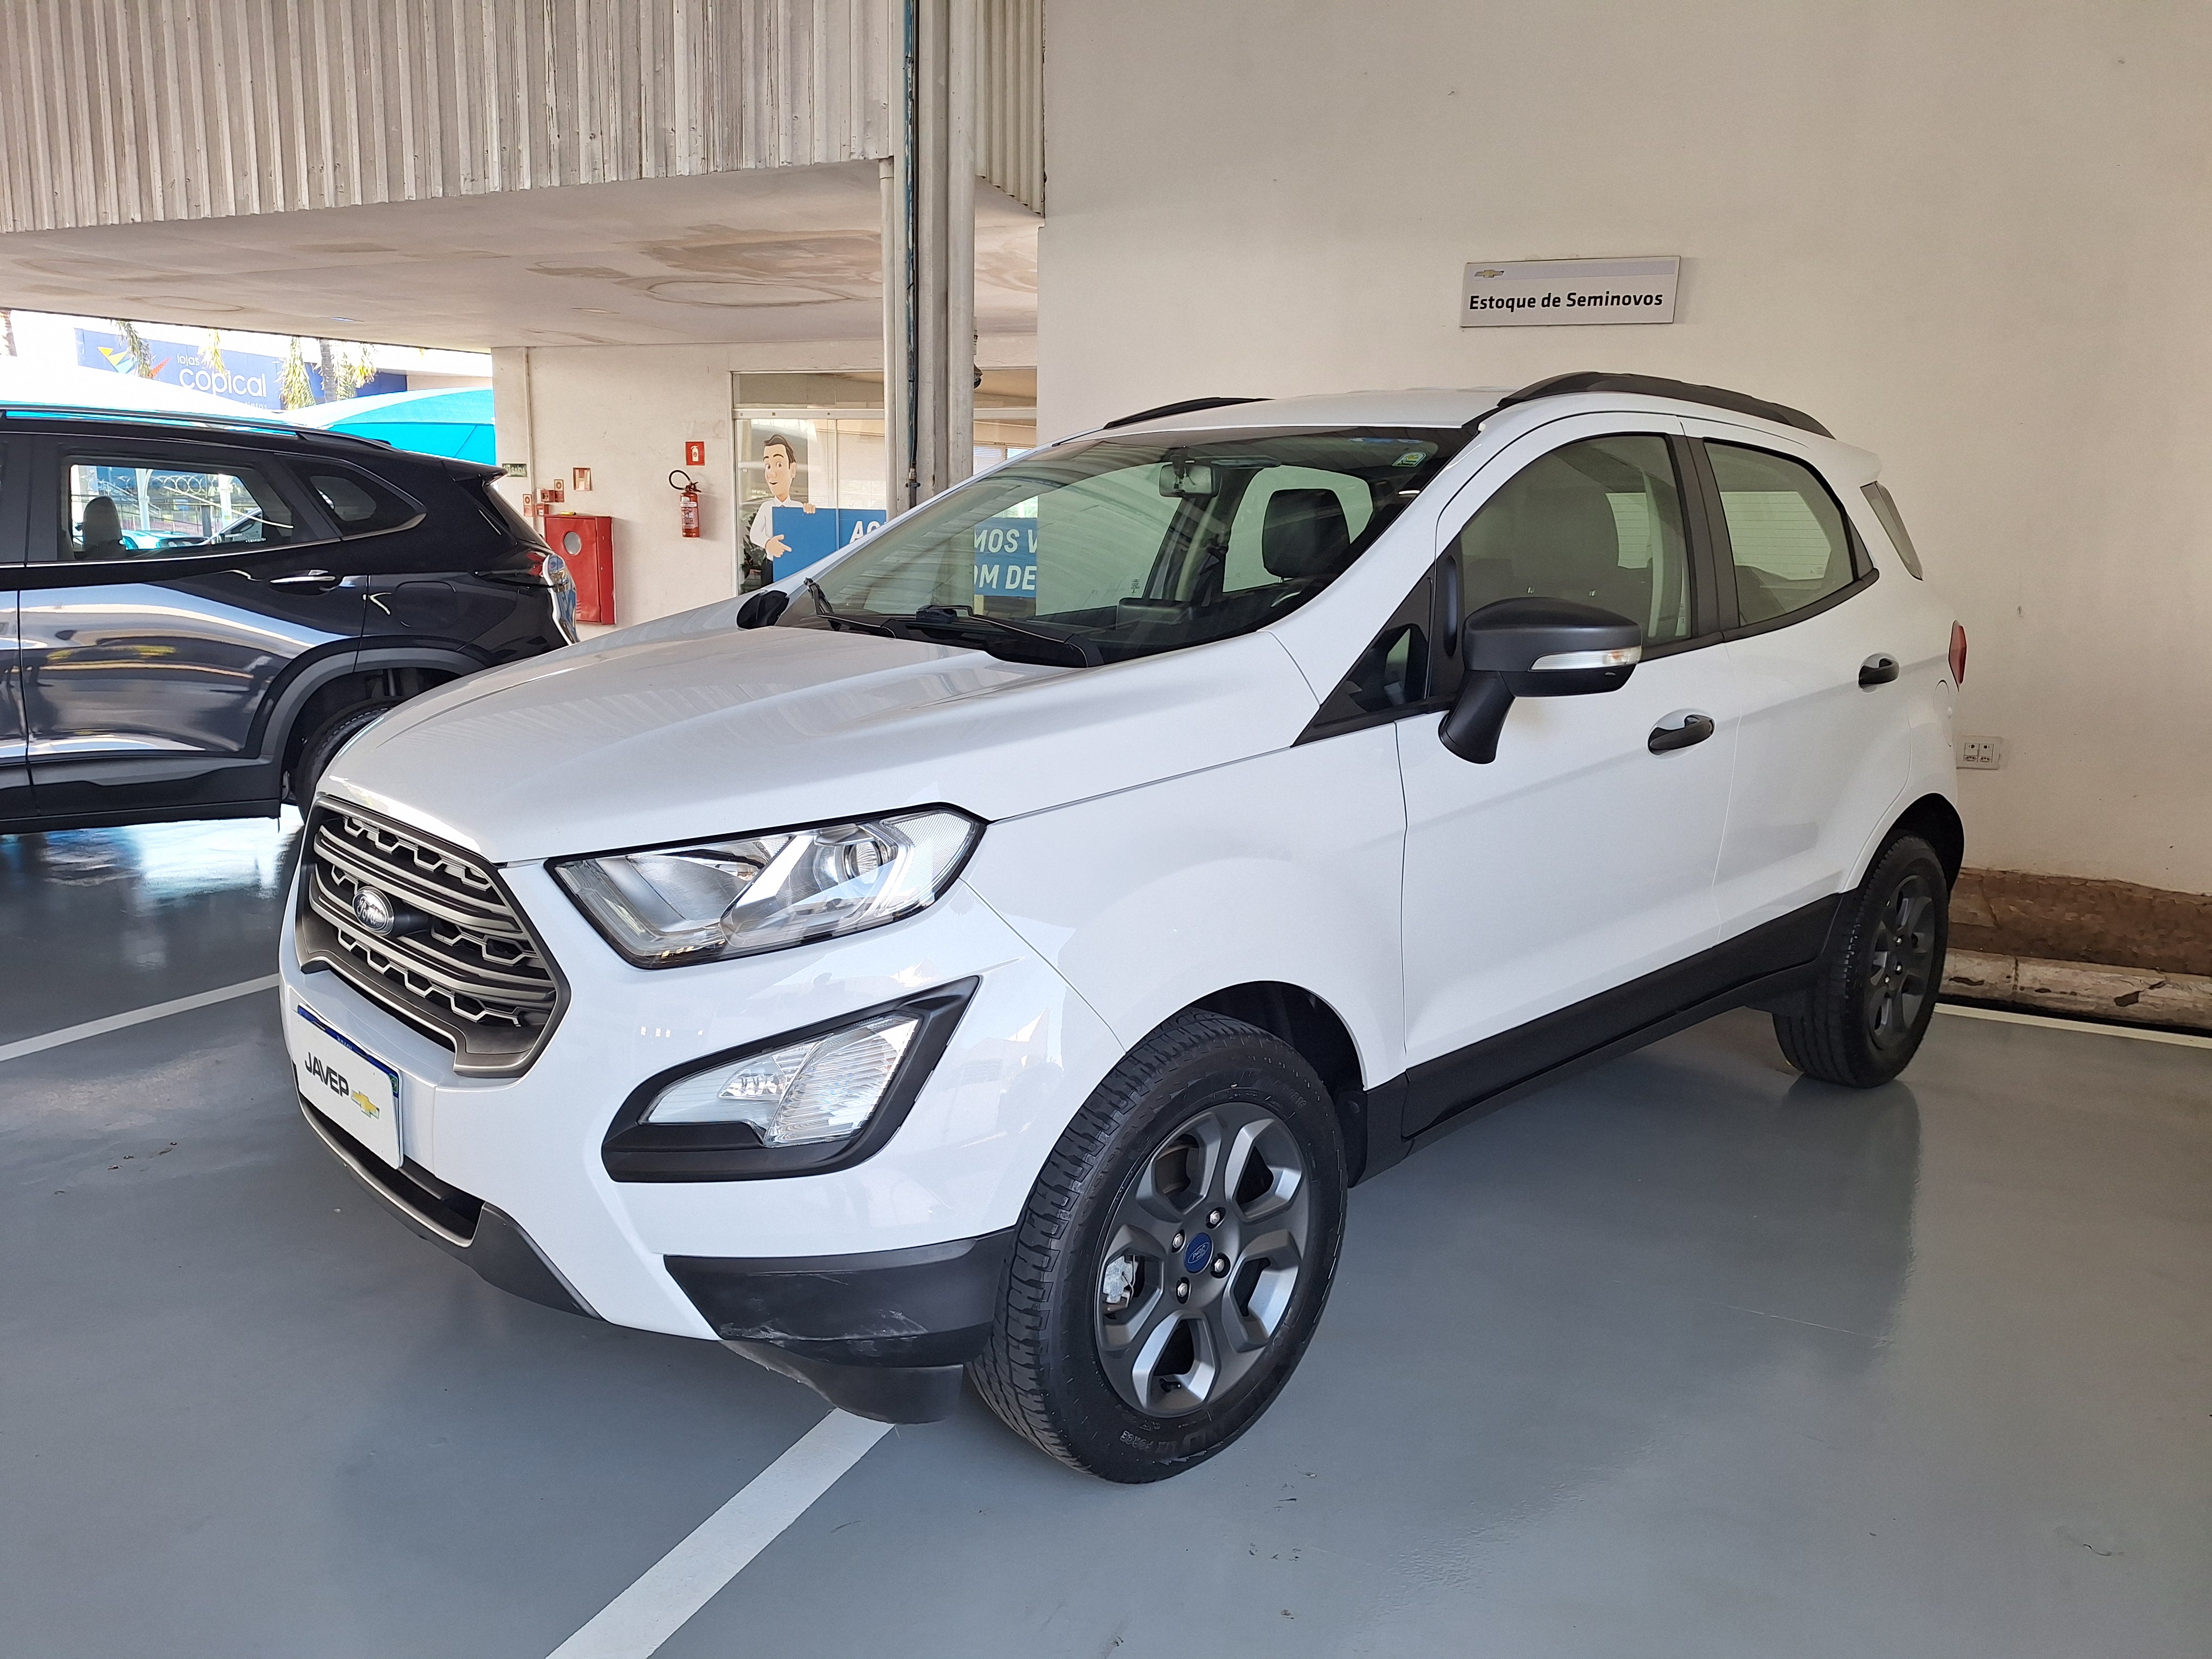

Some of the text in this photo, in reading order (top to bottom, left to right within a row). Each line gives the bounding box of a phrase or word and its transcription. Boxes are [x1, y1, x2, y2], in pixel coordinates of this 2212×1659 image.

[1469, 291, 1663, 313] Estoque de Seminovos
[177, 353, 200, 366] lojas
[178, 368, 267, 397] copical
[974, 564, 1000, 589] M
[356, 895, 378, 925] Ford
[304, 1051, 349, 1097] JAVEP
